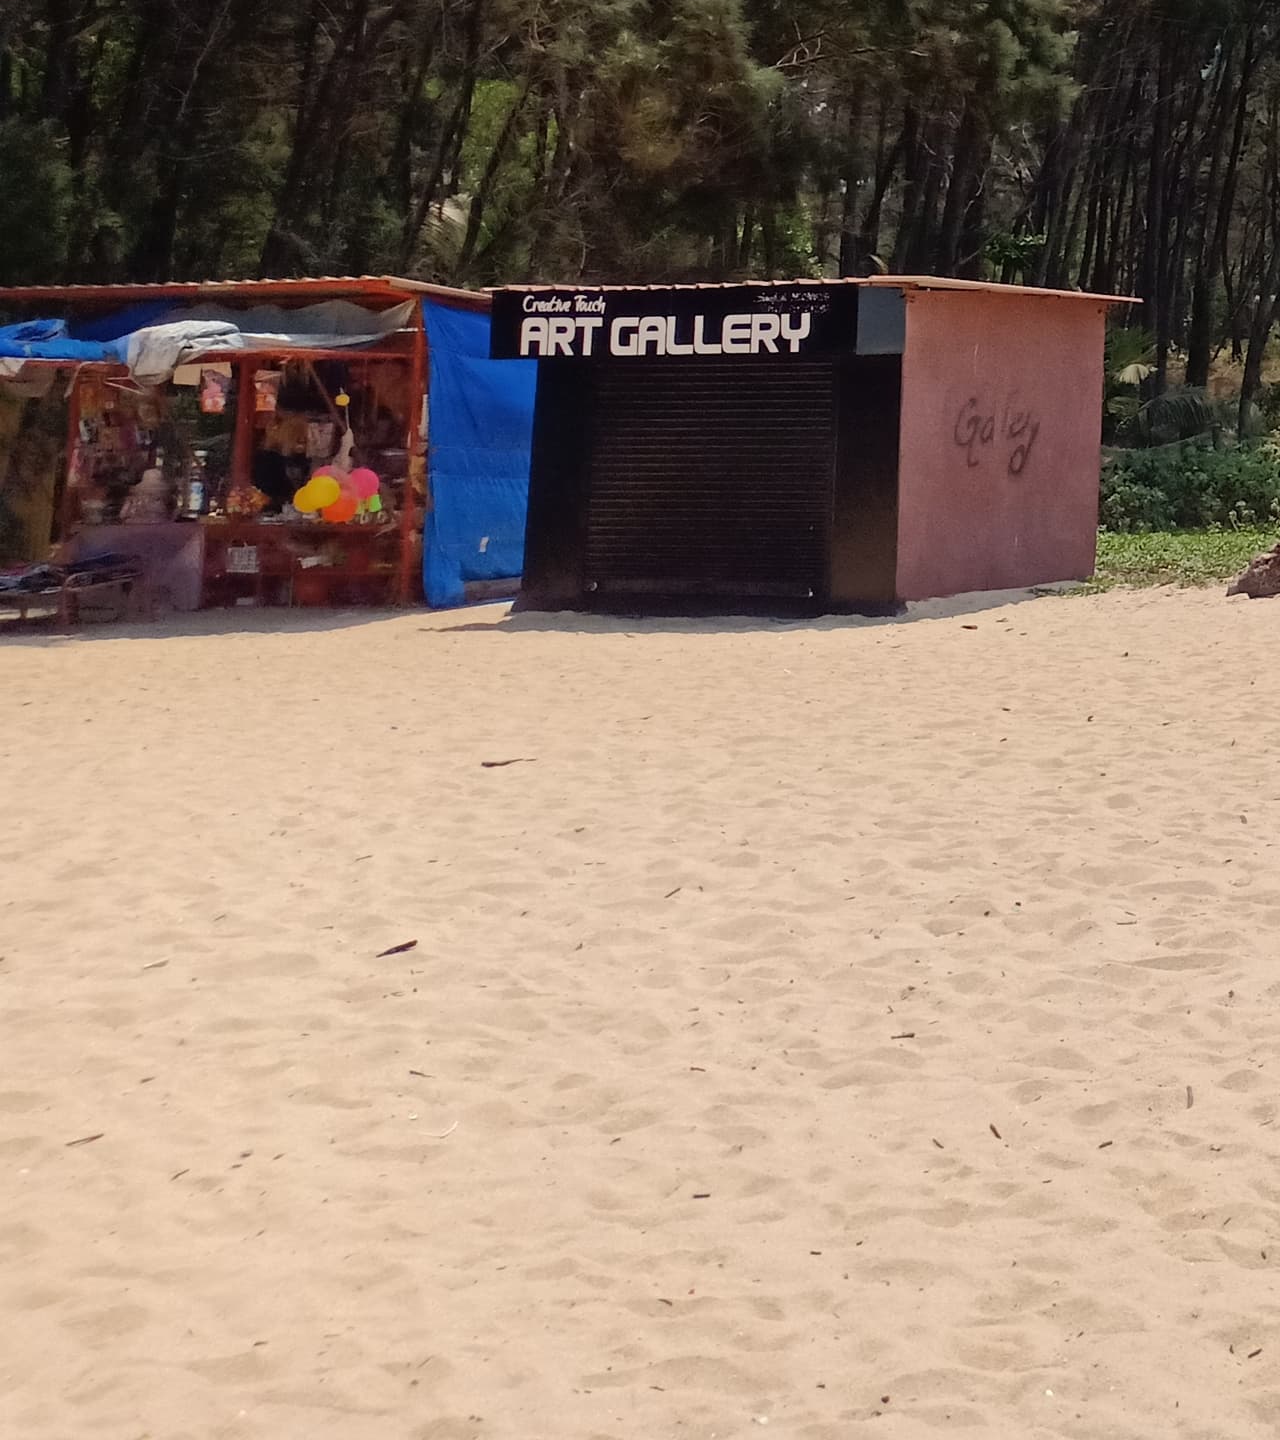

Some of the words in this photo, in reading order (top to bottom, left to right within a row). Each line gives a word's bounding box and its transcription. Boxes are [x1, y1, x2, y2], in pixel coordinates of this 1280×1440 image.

[523, 295, 571, 312] Creative
[574, 295, 606, 314] Touch
[520, 317, 603, 356] ART
[610, 312, 811, 356] GALLERY
